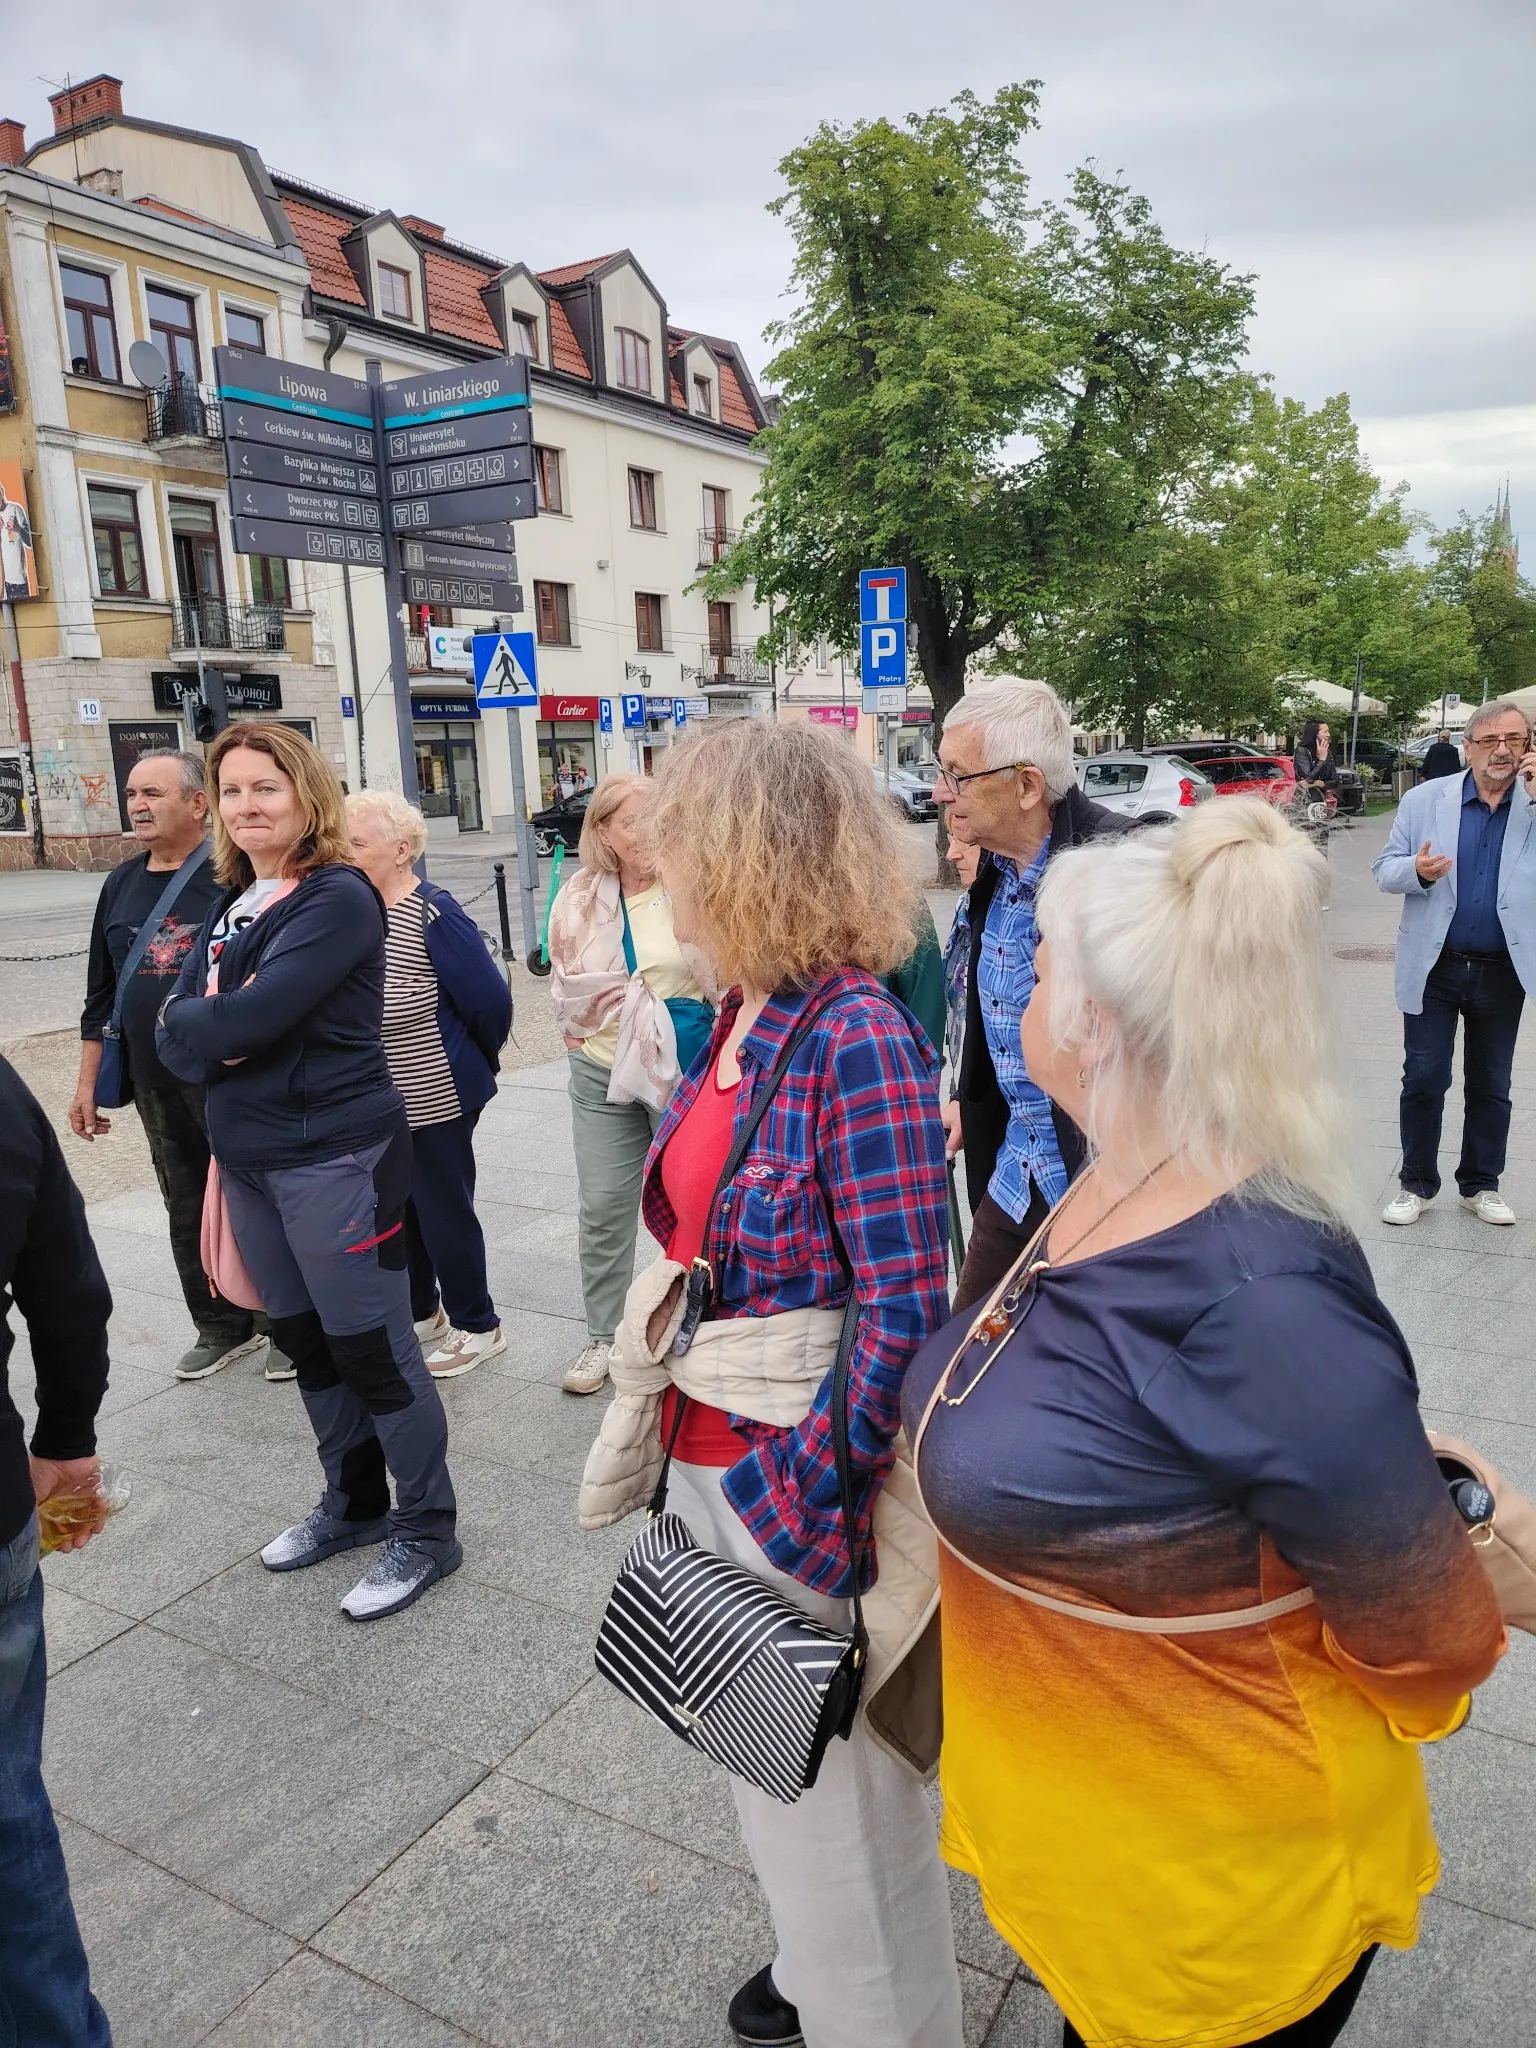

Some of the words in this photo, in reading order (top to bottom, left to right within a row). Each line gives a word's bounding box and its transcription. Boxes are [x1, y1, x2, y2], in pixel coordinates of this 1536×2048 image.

[279, 375, 328, 402] Lipowa
[404, 393, 420, 408] W.
[422, 378, 500, 405] Liniarskiego
[291, 402, 318, 416] Centrum
[439, 408, 465, 419] Centrum
[264, 421, 300, 439] Cerkiew
[301, 428, 316, 442] św.
[317, 432, 353, 450] Mikołaja
[409, 426, 455, 444] Uniwersytet
[410, 447, 418, 456] w
[419, 438, 466, 455] Białymstoku
[284, 455, 319, 472] Bazylika
[320, 461, 355, 479] Mniejsza
[299, 472, 315, 485] pw.
[316, 474, 332, 487] św.
[332, 477, 357, 490] Rocha
[287, 493, 322, 508] Dworzec
[323, 497, 339, 509] PKP
[289, 507, 323, 520] Dworzec
[324, 510, 340, 523] PKS
[465, 534, 496, 547] Medyczny
[425, 554, 449, 565] Centrum
[449, 557, 476, 569] Informacji
[477, 560, 507, 572] Turystycznej
[871, 627, 897, 669] P
[878, 675, 902, 683] Płatny
[225, 685, 271, 702] ALKOHOLI
[82, 703, 97, 715] 10
[420, 704, 443, 712] OPTYK
[557, 700, 588, 717] Cartier
[602, 701, 609, 723] P
[627, 697, 639, 718] P
[676, 702, 684, 722] P
[119, 732, 140, 741] DOM
[147, 732, 170, 741] WINA
[1477, 1491, 1489, 1516] ZERO
